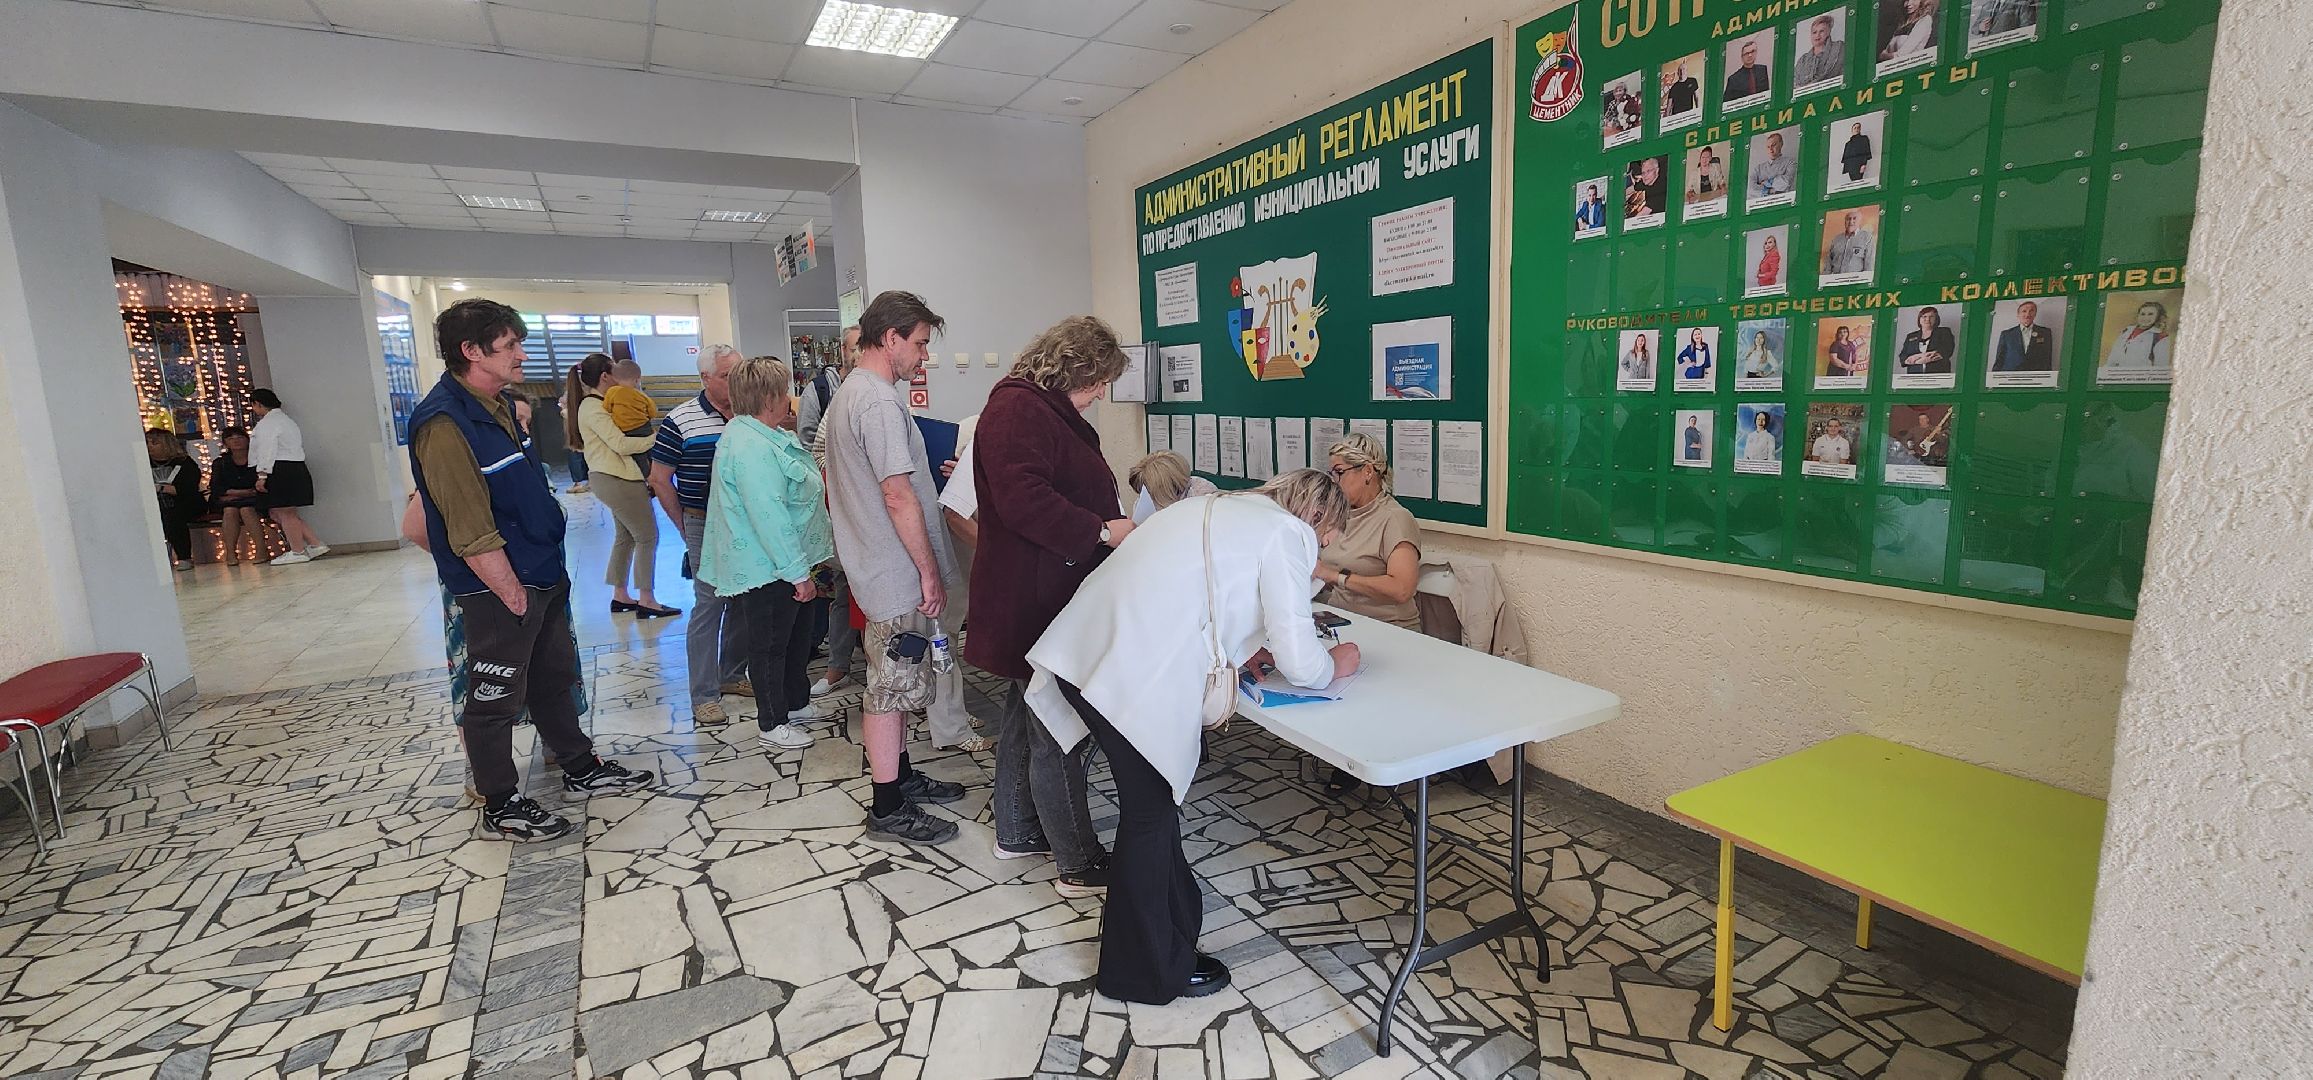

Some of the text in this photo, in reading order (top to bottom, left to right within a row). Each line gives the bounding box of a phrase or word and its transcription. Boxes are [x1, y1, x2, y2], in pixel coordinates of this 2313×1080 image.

[1533, 88, 1582, 120] ЦЕМЕНТНИК
[1685, 60, 1978, 148] СПЕЦИАЛИСТЫ
[1144, 69, 1468, 226] АДМИНИСТРАТИВНЫЙ РЕГЛАМЕНТ
[1142, 123, 1480, 256] ПО ПРЕДОСТАВЛЕНИЮ МУНИЦИПАЛЬНОЙ УСЛУГИ
[1566, 308, 1709, 331] РУКОВОДИТЕЛИ
[1729, 291, 1902, 319] ТВОРЧЕСКИХ
[1941, 266, 2187, 302] КОЛЛЕКТИВО
[473, 661, 516, 678] NIKE
[479, 681, 505, 696] NIKE
